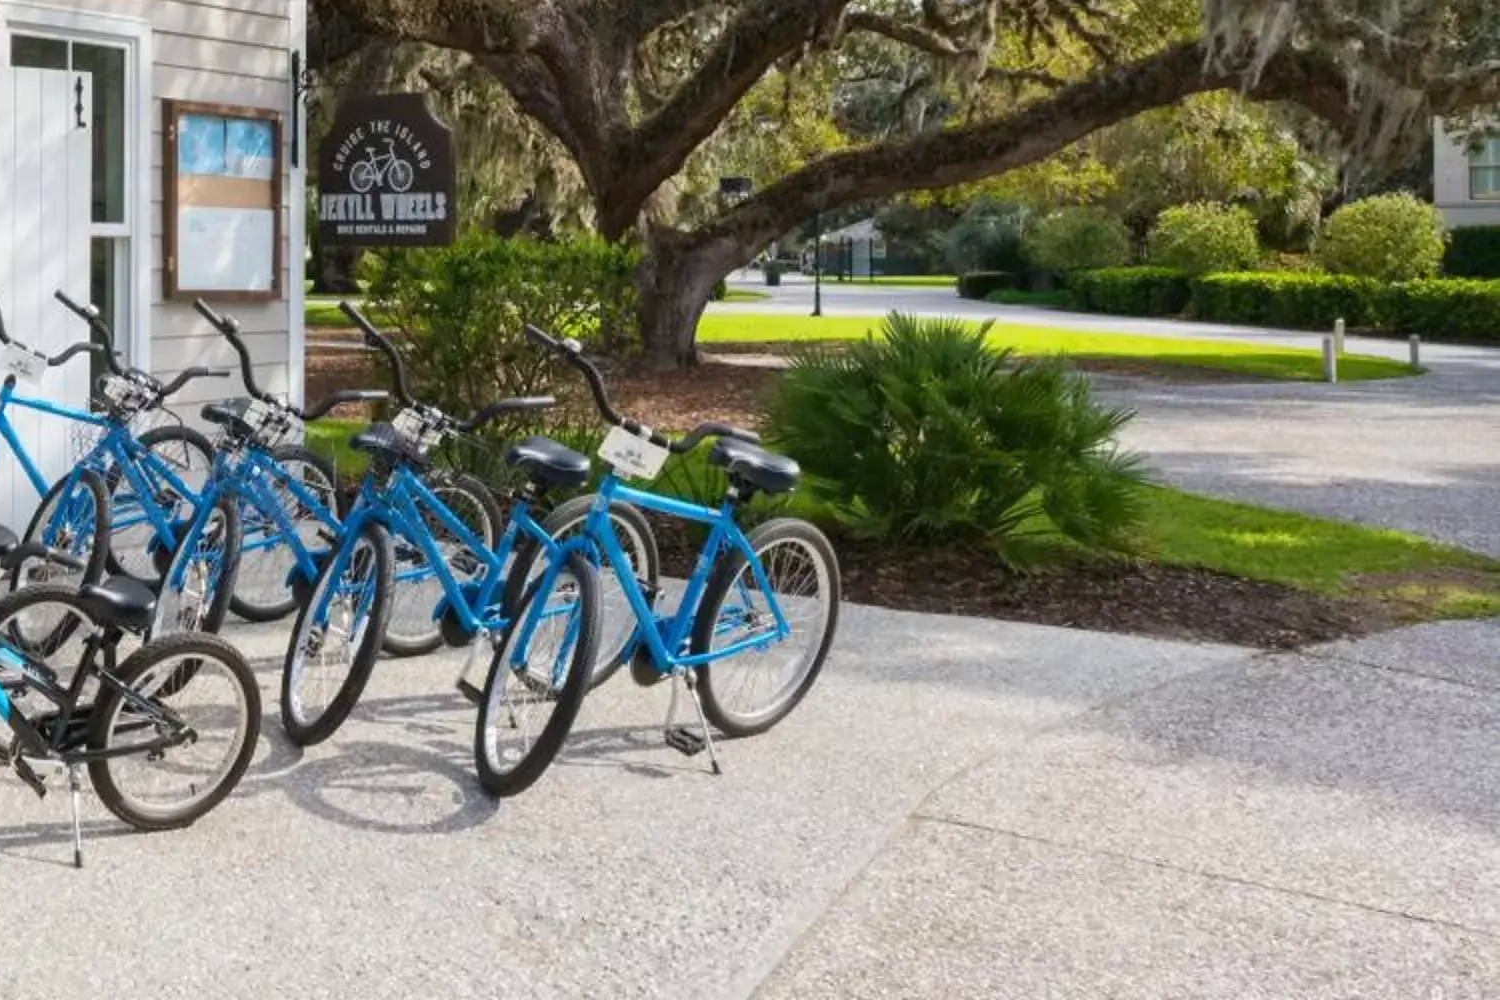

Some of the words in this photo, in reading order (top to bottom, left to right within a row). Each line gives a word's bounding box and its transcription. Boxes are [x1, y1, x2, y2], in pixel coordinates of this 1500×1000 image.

[396, 123, 431, 169] ISLAND
[320, 193, 375, 221] JEKYLL
[381, 192, 447, 221] WHEELS
